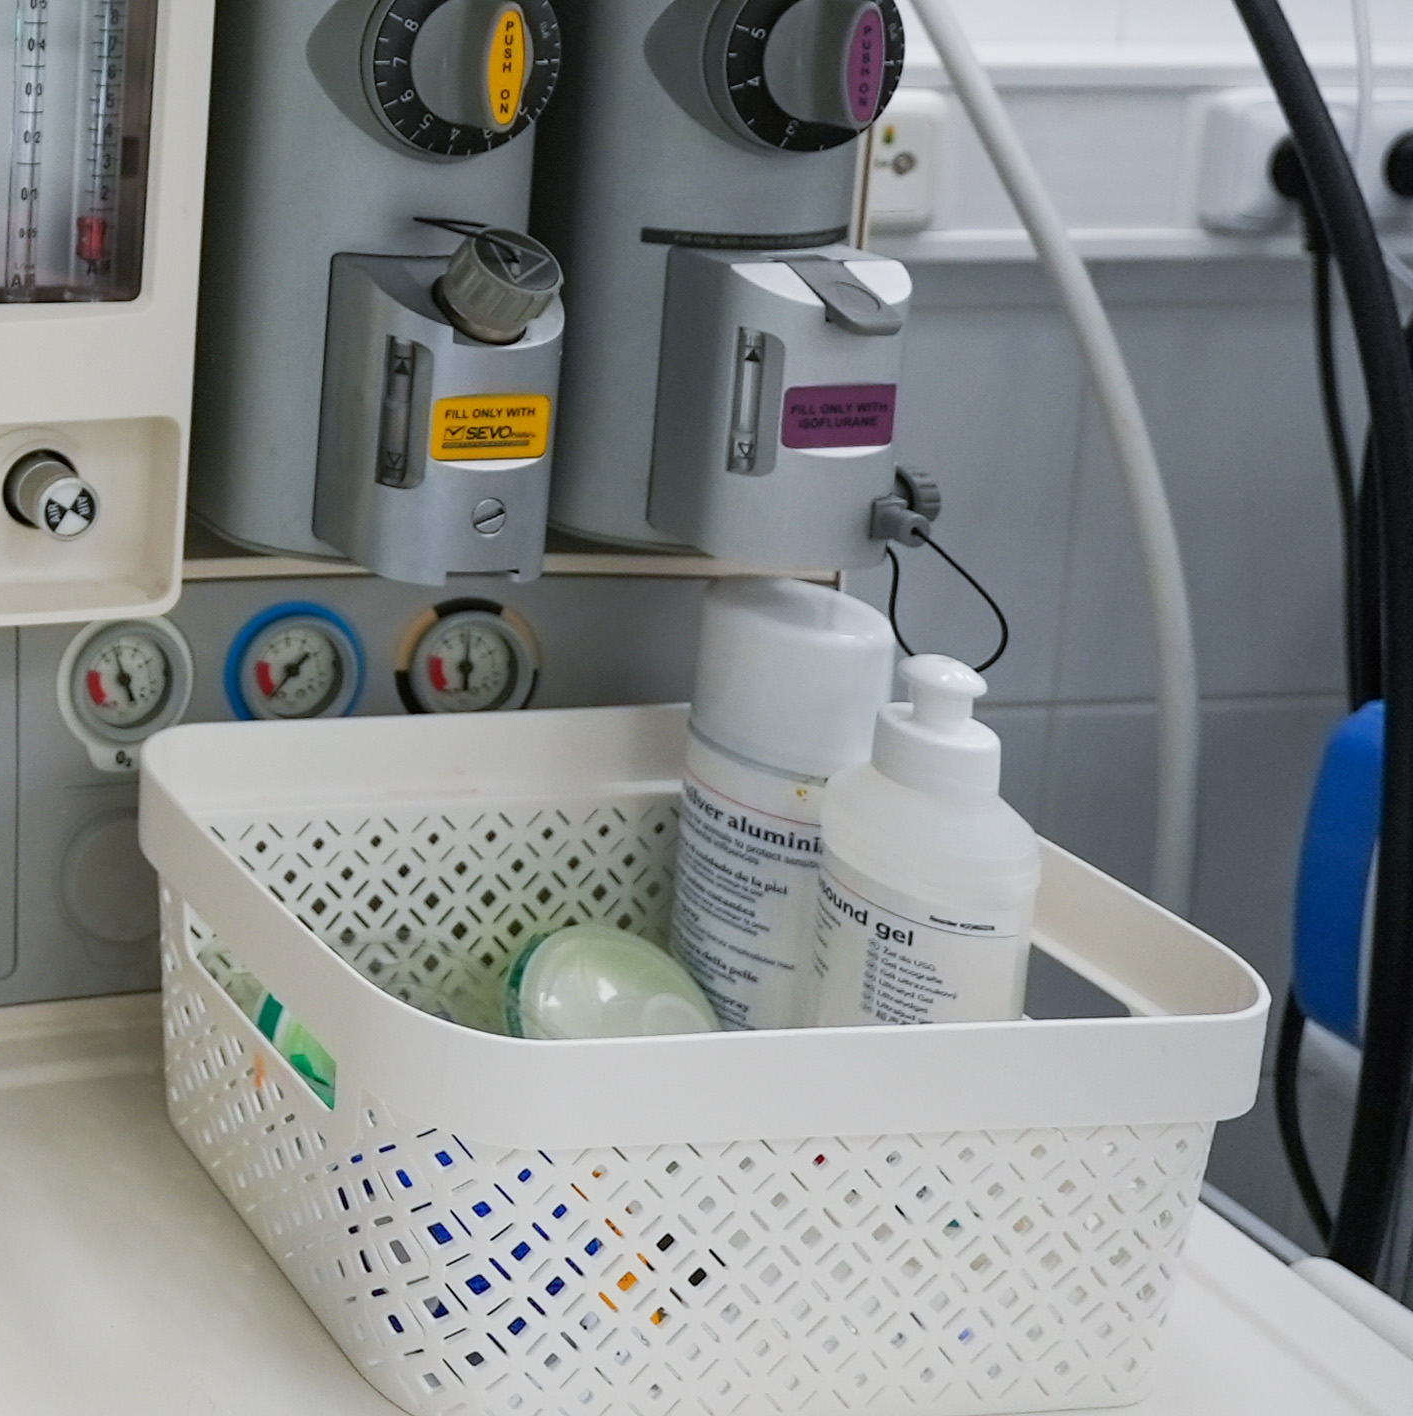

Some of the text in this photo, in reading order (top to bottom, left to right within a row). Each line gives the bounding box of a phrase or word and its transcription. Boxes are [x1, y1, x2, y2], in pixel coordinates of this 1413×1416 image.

[500, 20, 514, 114] PUSH ON
[445, 407, 536, 419] FILL ONLY WITH
[875, 921, 913, 946] gel
